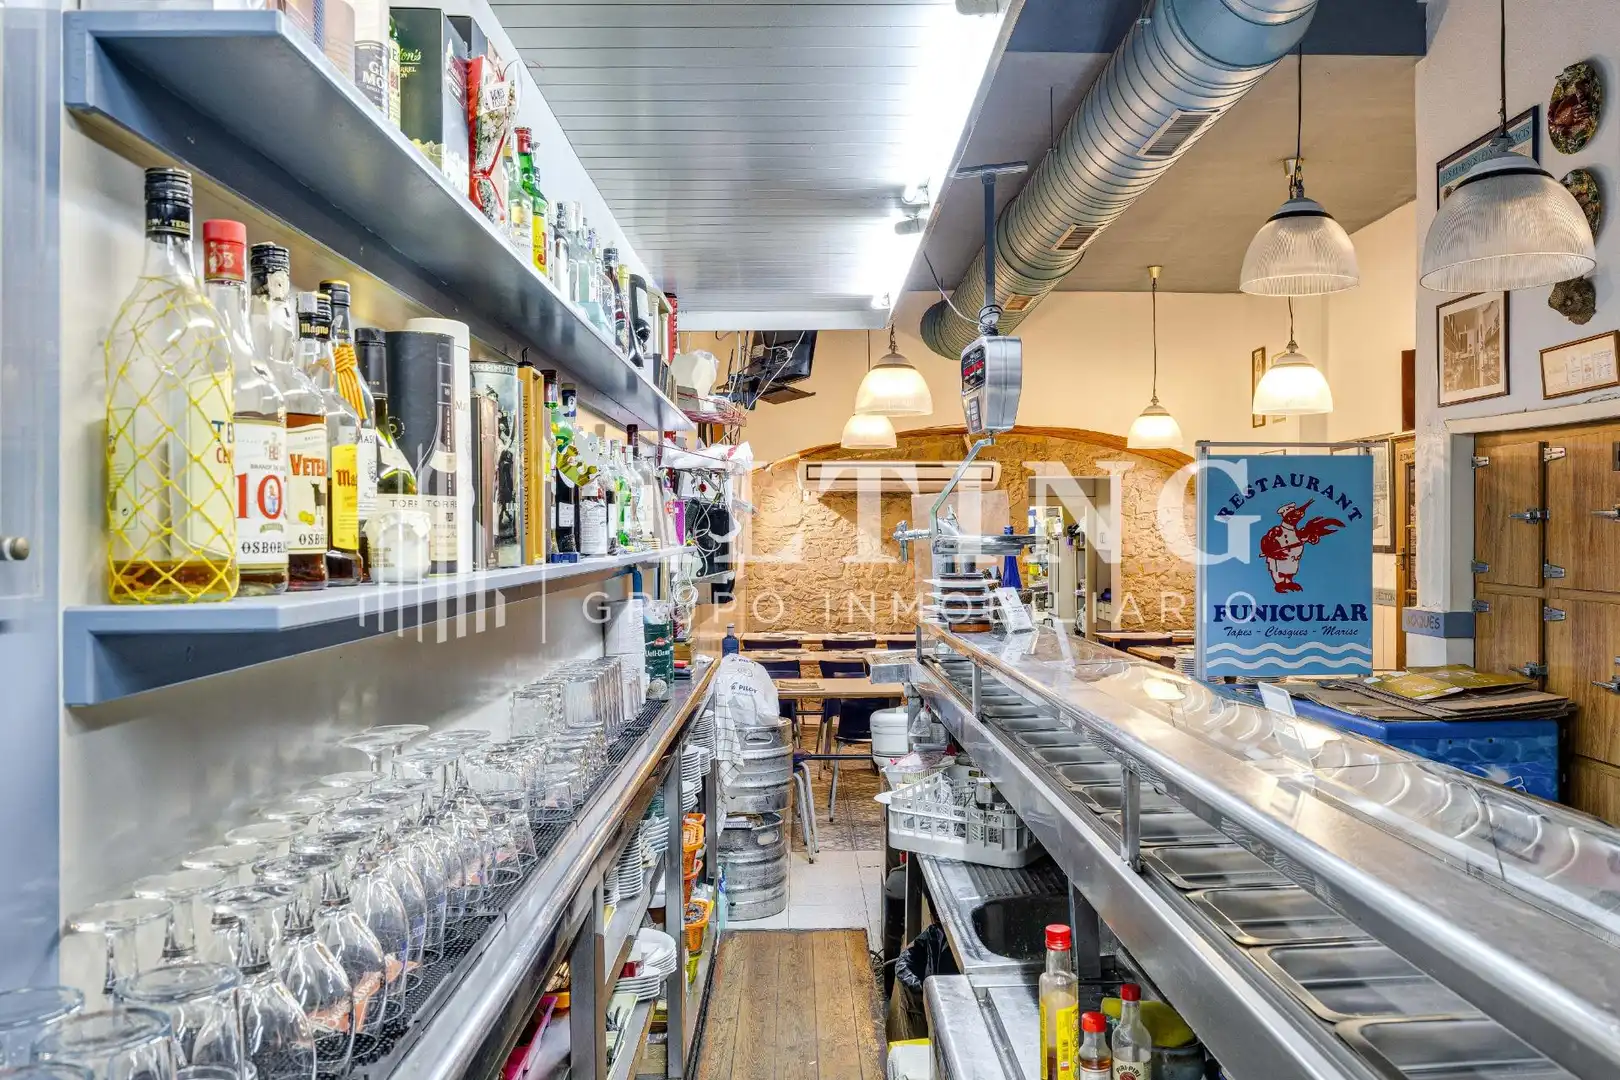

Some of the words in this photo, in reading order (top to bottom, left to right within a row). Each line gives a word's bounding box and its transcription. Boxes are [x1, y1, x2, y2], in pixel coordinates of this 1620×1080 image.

[235, 472, 288, 520] 10
[1217, 472, 1363, 523] RESTAURANT
[1213, 603, 1368, 622] FUNICULAR
[1224, 626, 1253, 638] Tapes
